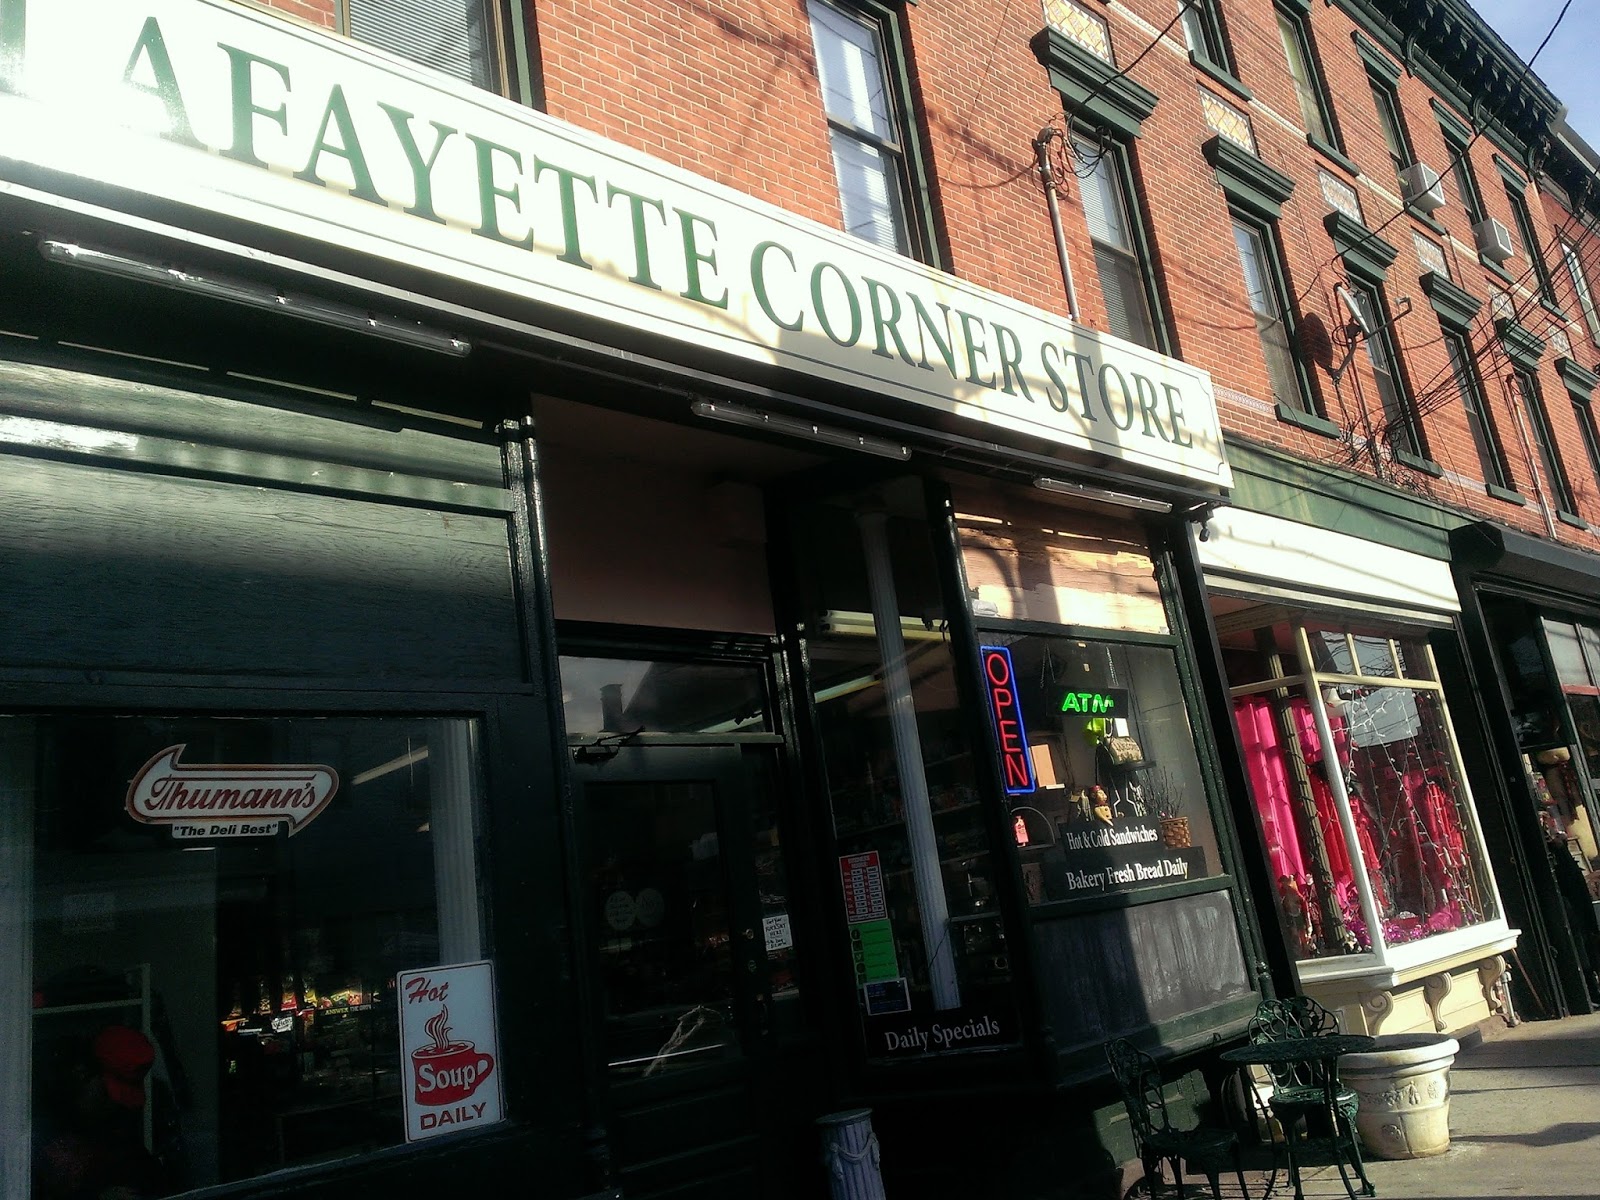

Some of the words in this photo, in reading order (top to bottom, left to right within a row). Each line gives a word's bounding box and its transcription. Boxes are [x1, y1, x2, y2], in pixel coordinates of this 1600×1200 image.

[750, 240, 1035, 404] CORNER
[1040, 341, 1194, 450] STORE
[1062, 692, 1115, 714] ATM
[986, 652, 1030, 787] OPEN
[143, 773, 317, 811] Thumann's
[209, 825, 236, 836] Deli
[1066, 832, 1084, 850] Hot
[1082, 831, 1092, 849] &
[1090, 828, 1111, 847] Cold
[1109, 824, 1159, 847] Sandwiches
[1066, 869, 1106, 892] Bakery
[1105, 863, 1136, 885] Fresh
[1134, 859, 1165, 881] Bread
[1162, 857, 1189, 880] Daily
[405, 976, 449, 1005] Hot
[884, 1026, 929, 1052] Daily
[932, 1015, 1000, 1048] Specials
[417, 1063, 477, 1094] Soup
[420, 1102, 487, 1130] DAILY
